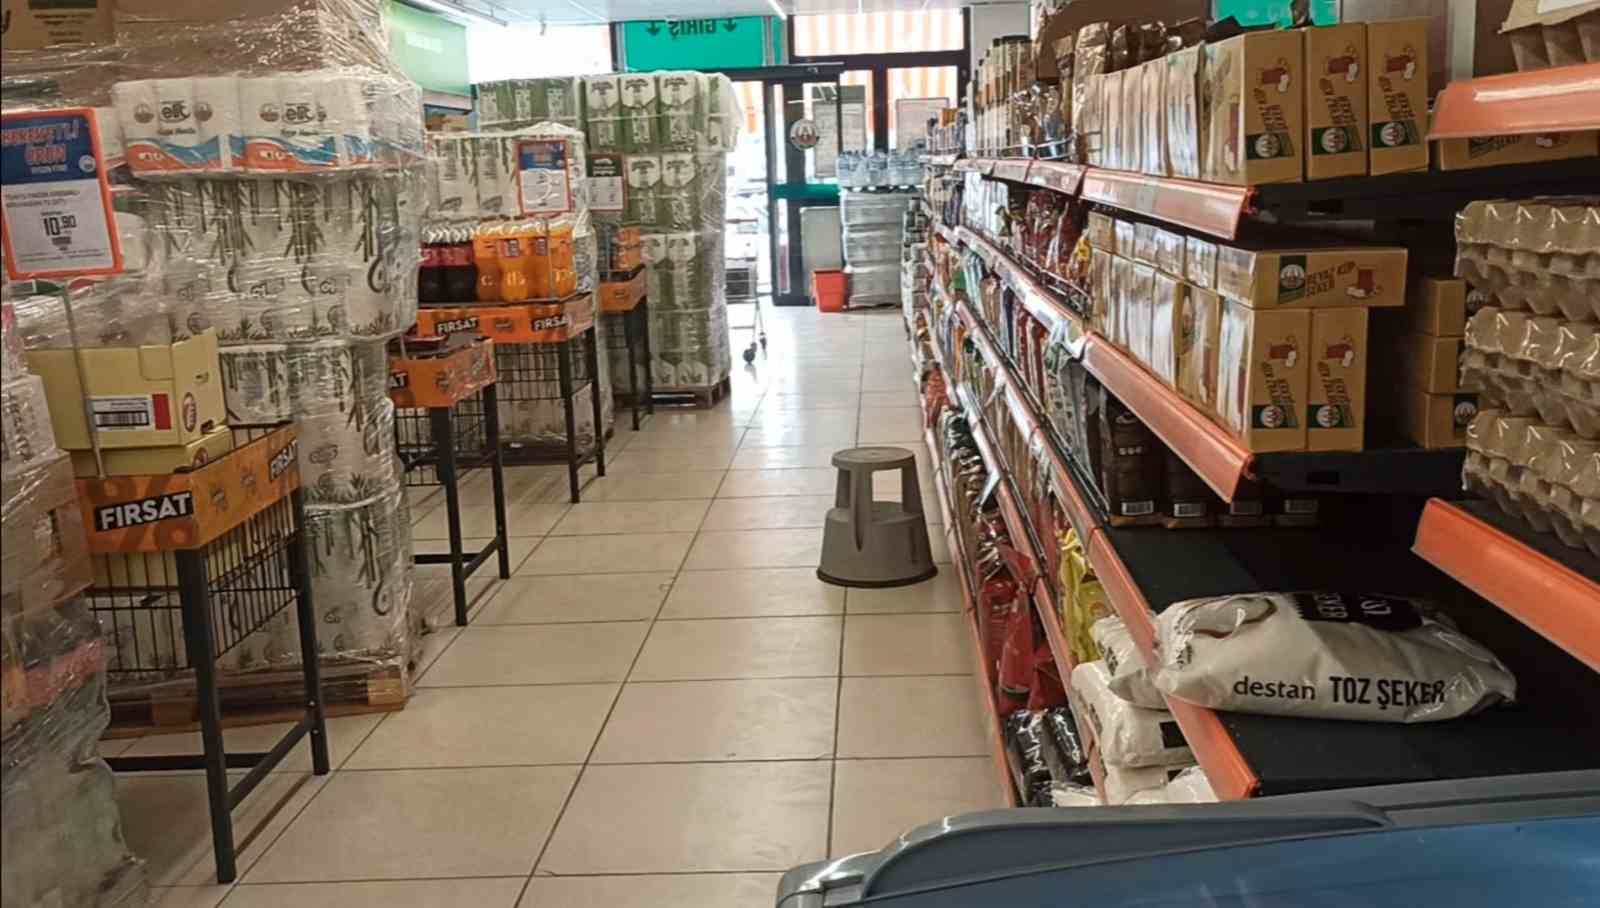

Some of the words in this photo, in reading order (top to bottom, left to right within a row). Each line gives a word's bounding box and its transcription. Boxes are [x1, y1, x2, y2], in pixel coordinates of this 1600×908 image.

[100, 492, 191, 530] FIRSAT
[1233, 676, 1316, 700] destan
[1329, 676, 1371, 704] TOZ
[1376, 679, 1446, 710] ŞEKER
